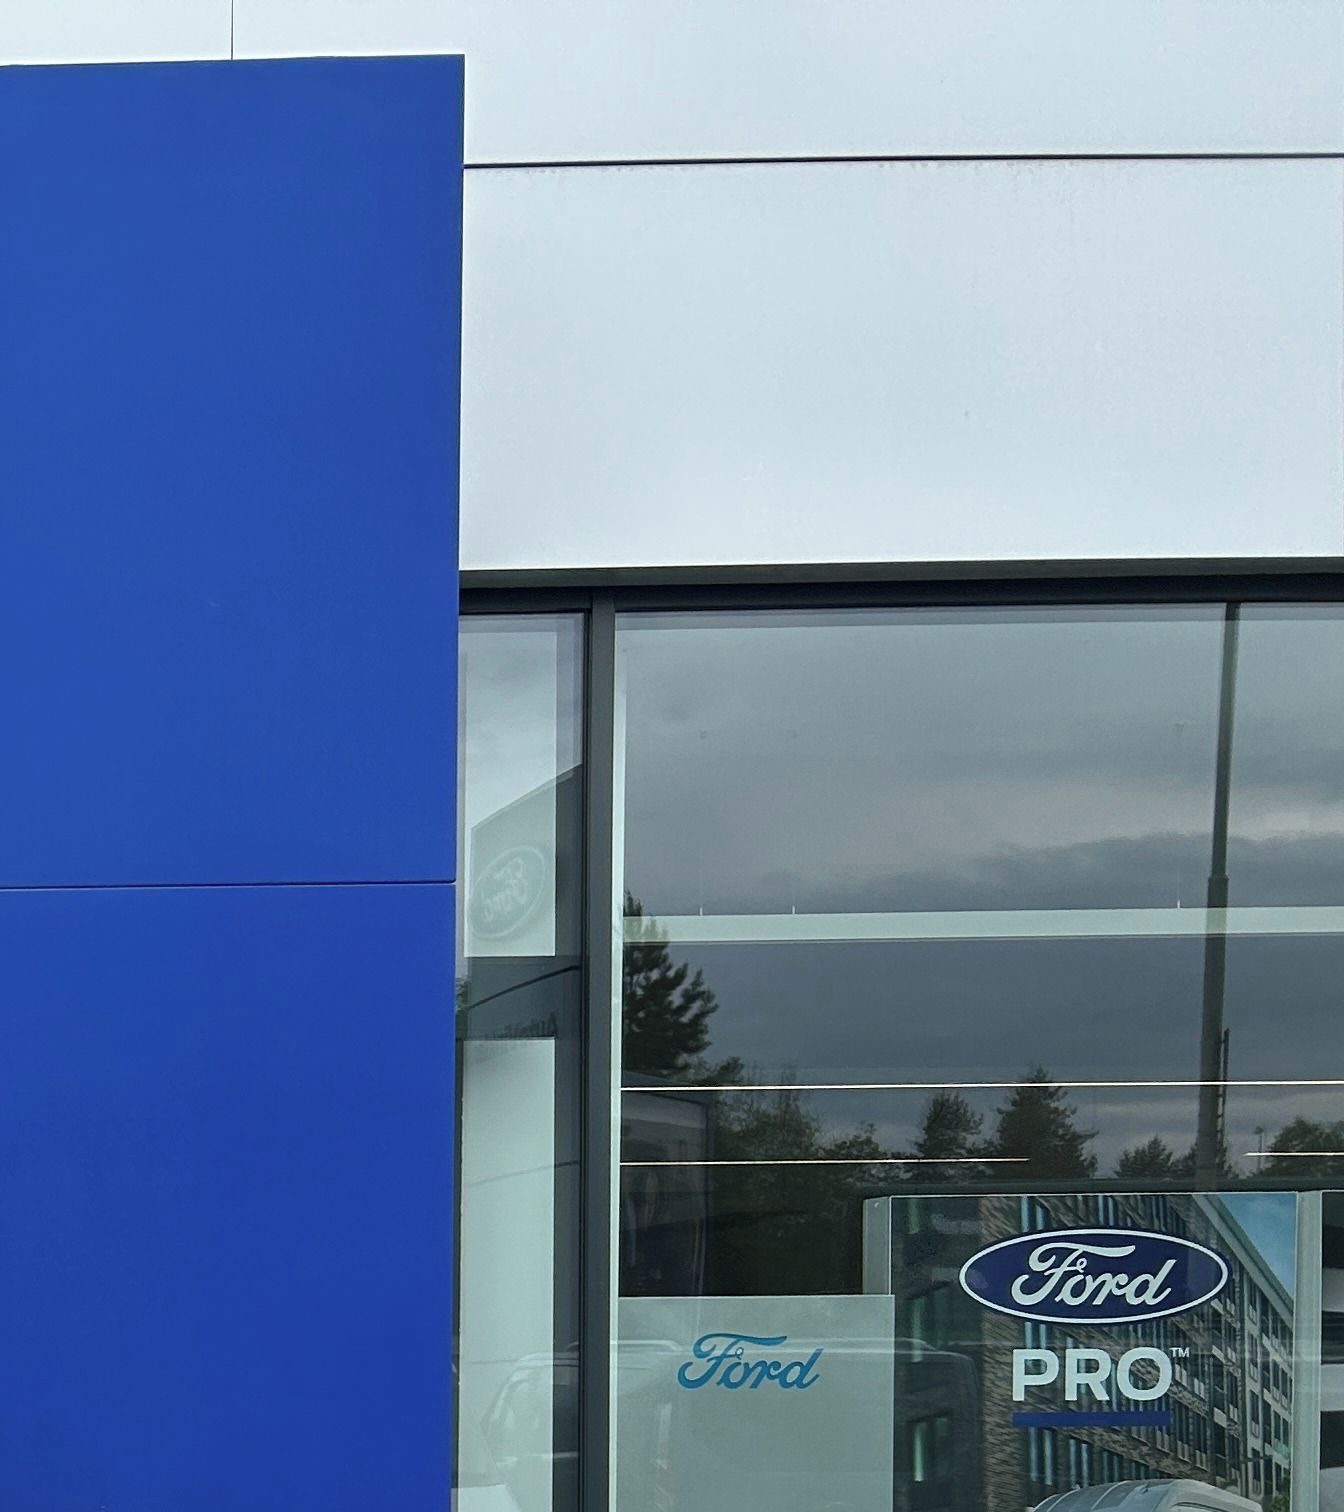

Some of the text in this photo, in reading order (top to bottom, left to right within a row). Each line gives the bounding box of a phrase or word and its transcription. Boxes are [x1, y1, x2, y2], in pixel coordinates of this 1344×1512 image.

[1011, 1242, 1177, 1306] Ford
[678, 1333, 824, 1389] Ford
[1012, 1347, 1172, 1401] PRO
